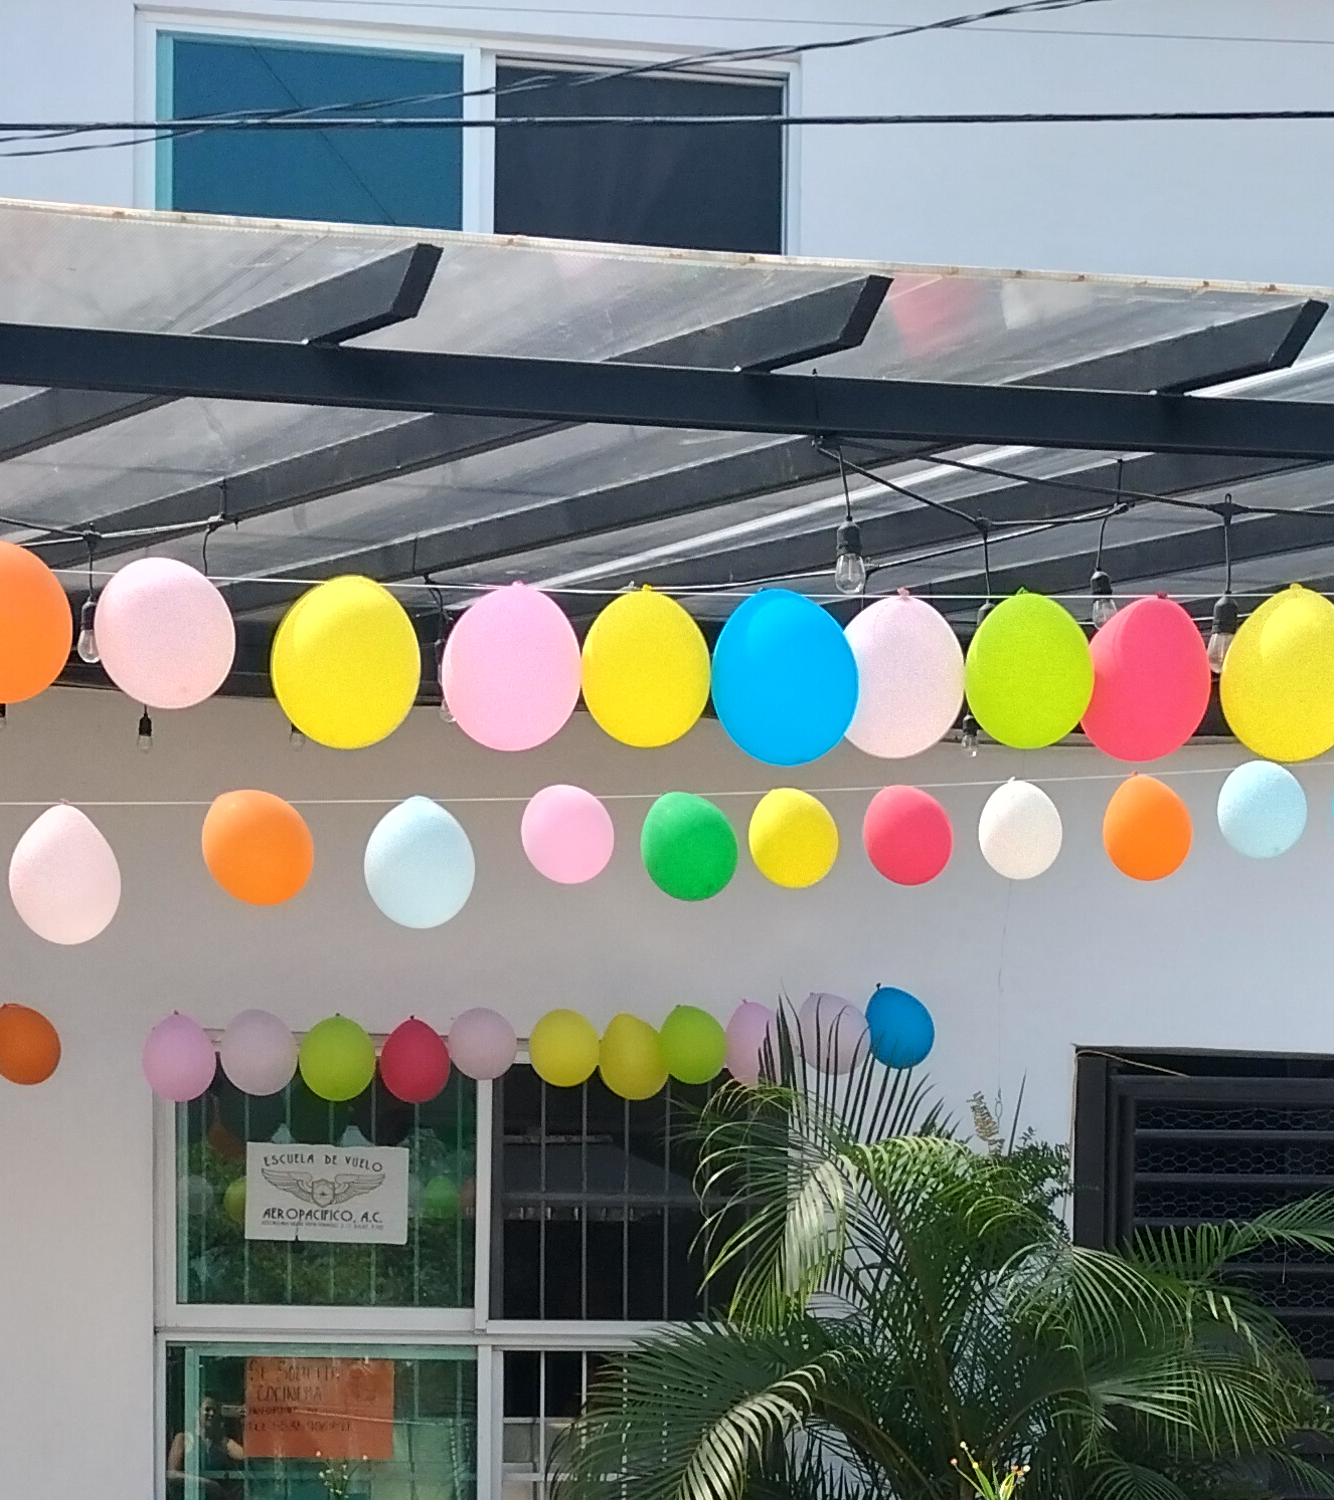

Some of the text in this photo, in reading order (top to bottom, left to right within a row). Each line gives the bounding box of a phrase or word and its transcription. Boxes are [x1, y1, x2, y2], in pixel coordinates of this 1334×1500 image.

[263, 1153, 383, 1172] ESCUELA DE VUELO
[360, 1211, 383, 1223] A.C.
